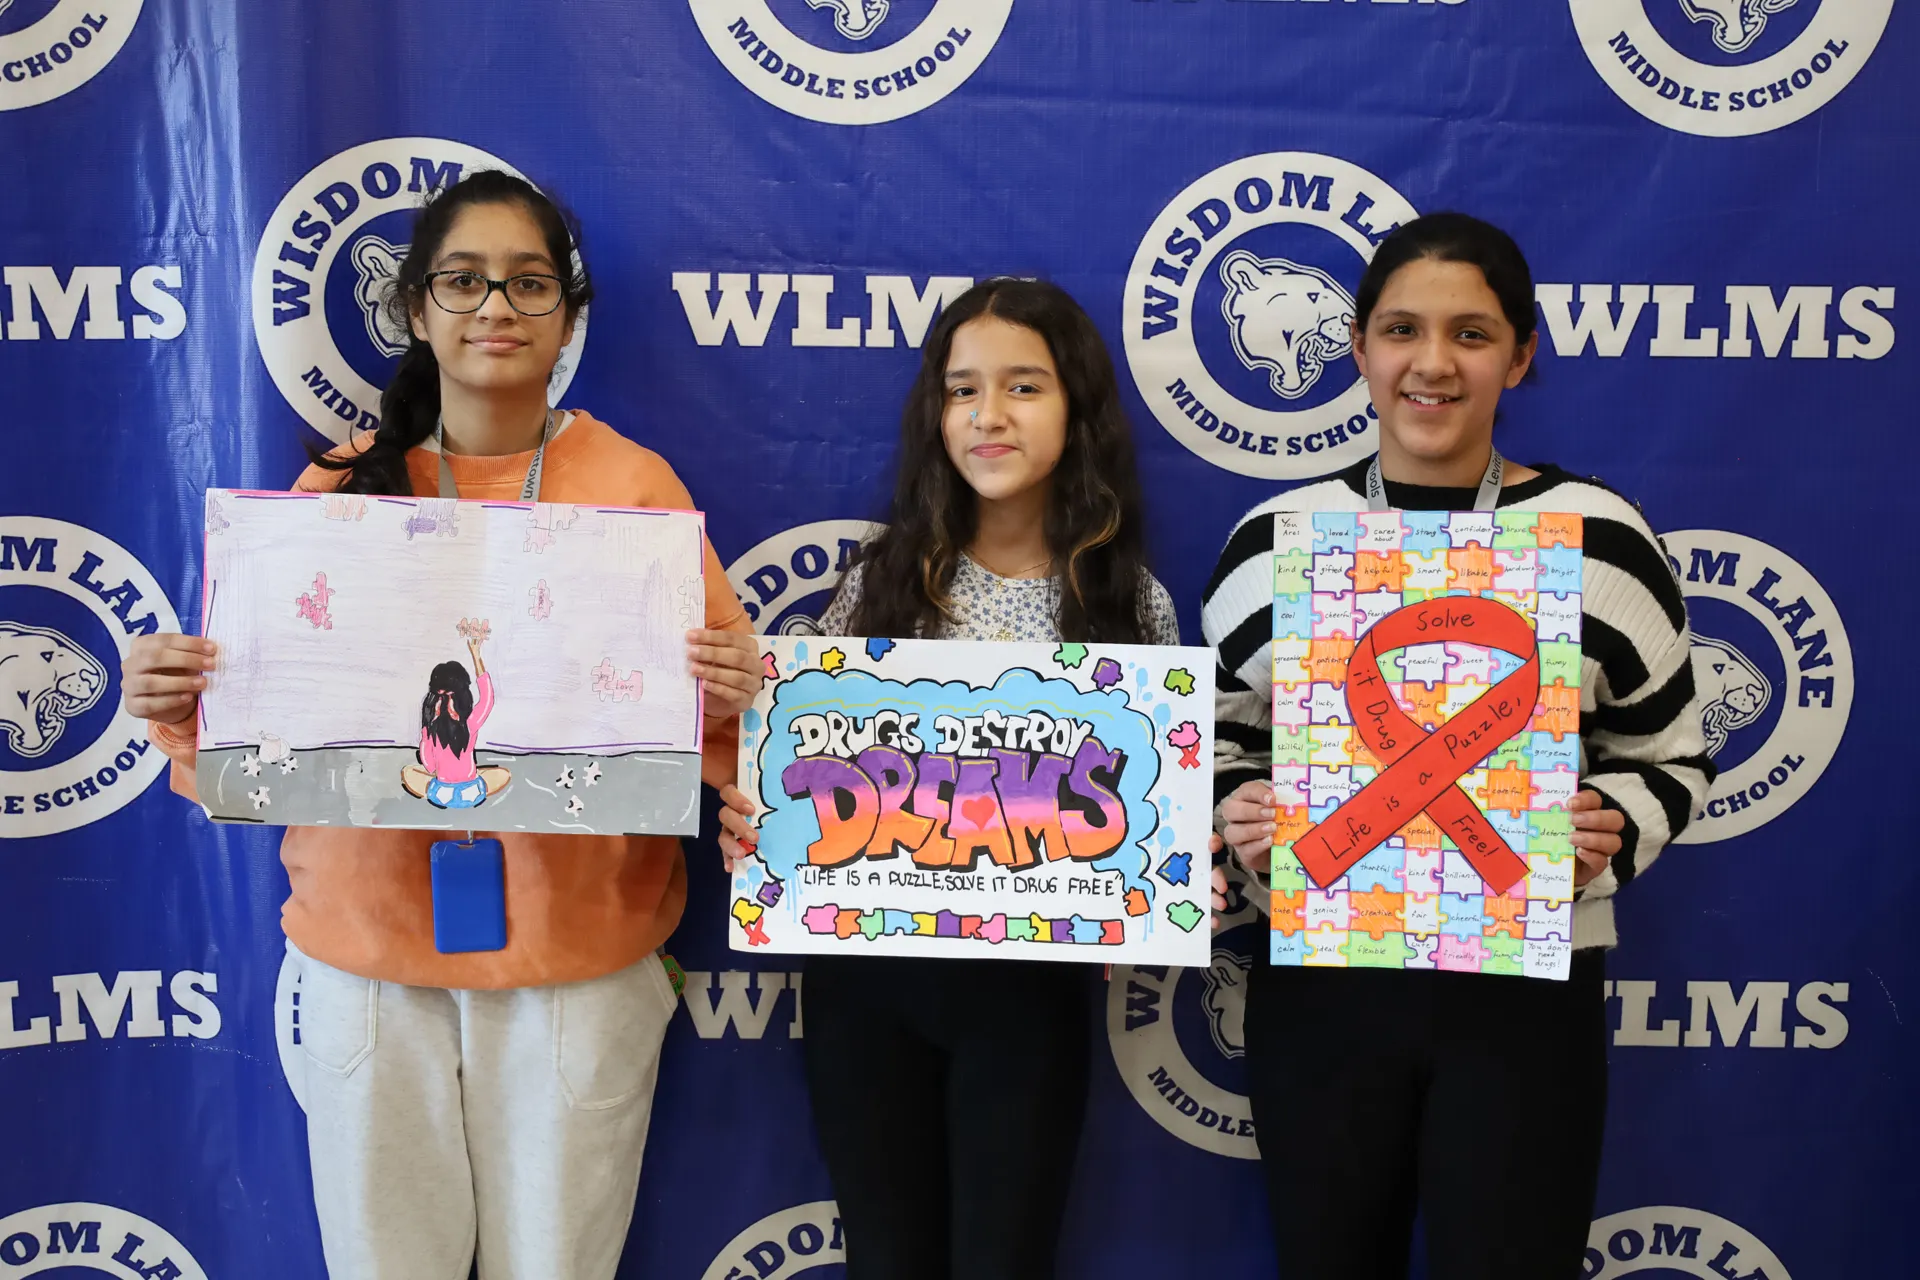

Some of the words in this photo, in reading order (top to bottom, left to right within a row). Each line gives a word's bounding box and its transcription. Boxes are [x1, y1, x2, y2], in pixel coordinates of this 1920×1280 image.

[0, 13, 108, 83] CHOOL
[726, 16, 845, 99] MIDDLE
[854, 24, 972, 100] SCHOOL
[1608, 30, 1720, 111] MIDDLE
[1728, 36, 1849, 112] SCHOOL
[273, 156, 463, 326] WISDOM
[1142, 171, 1334, 340] WISDOM
[0, 265, 187, 341] MS
[672, 272, 974, 349] WLM
[1535, 283, 1895, 360] WLMS
[301, 365, 380, 431] MIDD
[1166, 378, 1279, 456] MIDDLE
[1287, 401, 1380, 456] SCHOO
[1281, 518, 1298, 528] You
[1328, 528, 1349, 536] loved
[1373, 527, 1396, 535] cared
[1506, 525, 1527, 533] brave
[1277, 564, 1297, 574] kind
[1319, 564, 1343, 575] gifted
[1325, 610, 1352, 619] cheerful
[1416, 608, 1475, 631] Solve
[1747, 567, 1834, 708] LANE
[1316, 656, 1342, 666] patient
[1407, 656, 1438, 665] peaceful
[1315, 699, 1336, 708] lucky
[1353, 669, 1377, 687] it
[1366, 700, 1397, 750] Drug
[1417, 700, 1431, 708] fun
[789, 709, 925, 758] DRUGS
[933, 709, 1093, 758] DESTROY
[1501, 746, 1519, 755] good
[34, 737, 150, 813] SCHOOL
[1321, 817, 1371, 860] Life
[1383, 796, 1400, 812] is
[1419, 771, 1433, 785] a
[1443, 697, 1521, 759] Puzzle,
[1696, 752, 1805, 820] CHOOL
[782, 736, 1129, 873] DREAMS
[1452, 814, 1499, 857] Free!
[846, 870, 861, 886] IS
[868, 871, 881, 885] A
[992, 876, 1007, 892] IT
[1014, 876, 1058, 894] DRUG
[1275, 863, 1291, 872] safe
[1408, 868, 1427, 876] kind
[1312, 907, 1338, 915] genius
[1360, 909, 1392, 917] creative
[1411, 910, 1428, 919] fair
[1451, 914, 1482, 922] cheerful
[1528, 942, 1542, 950] You
[0, 970, 222, 1049] LMS
[1604, 980, 1849, 1049] LMS
[1148, 1066, 1254, 1138] MIDDLE
[111, 1232, 182, 1280] LA
